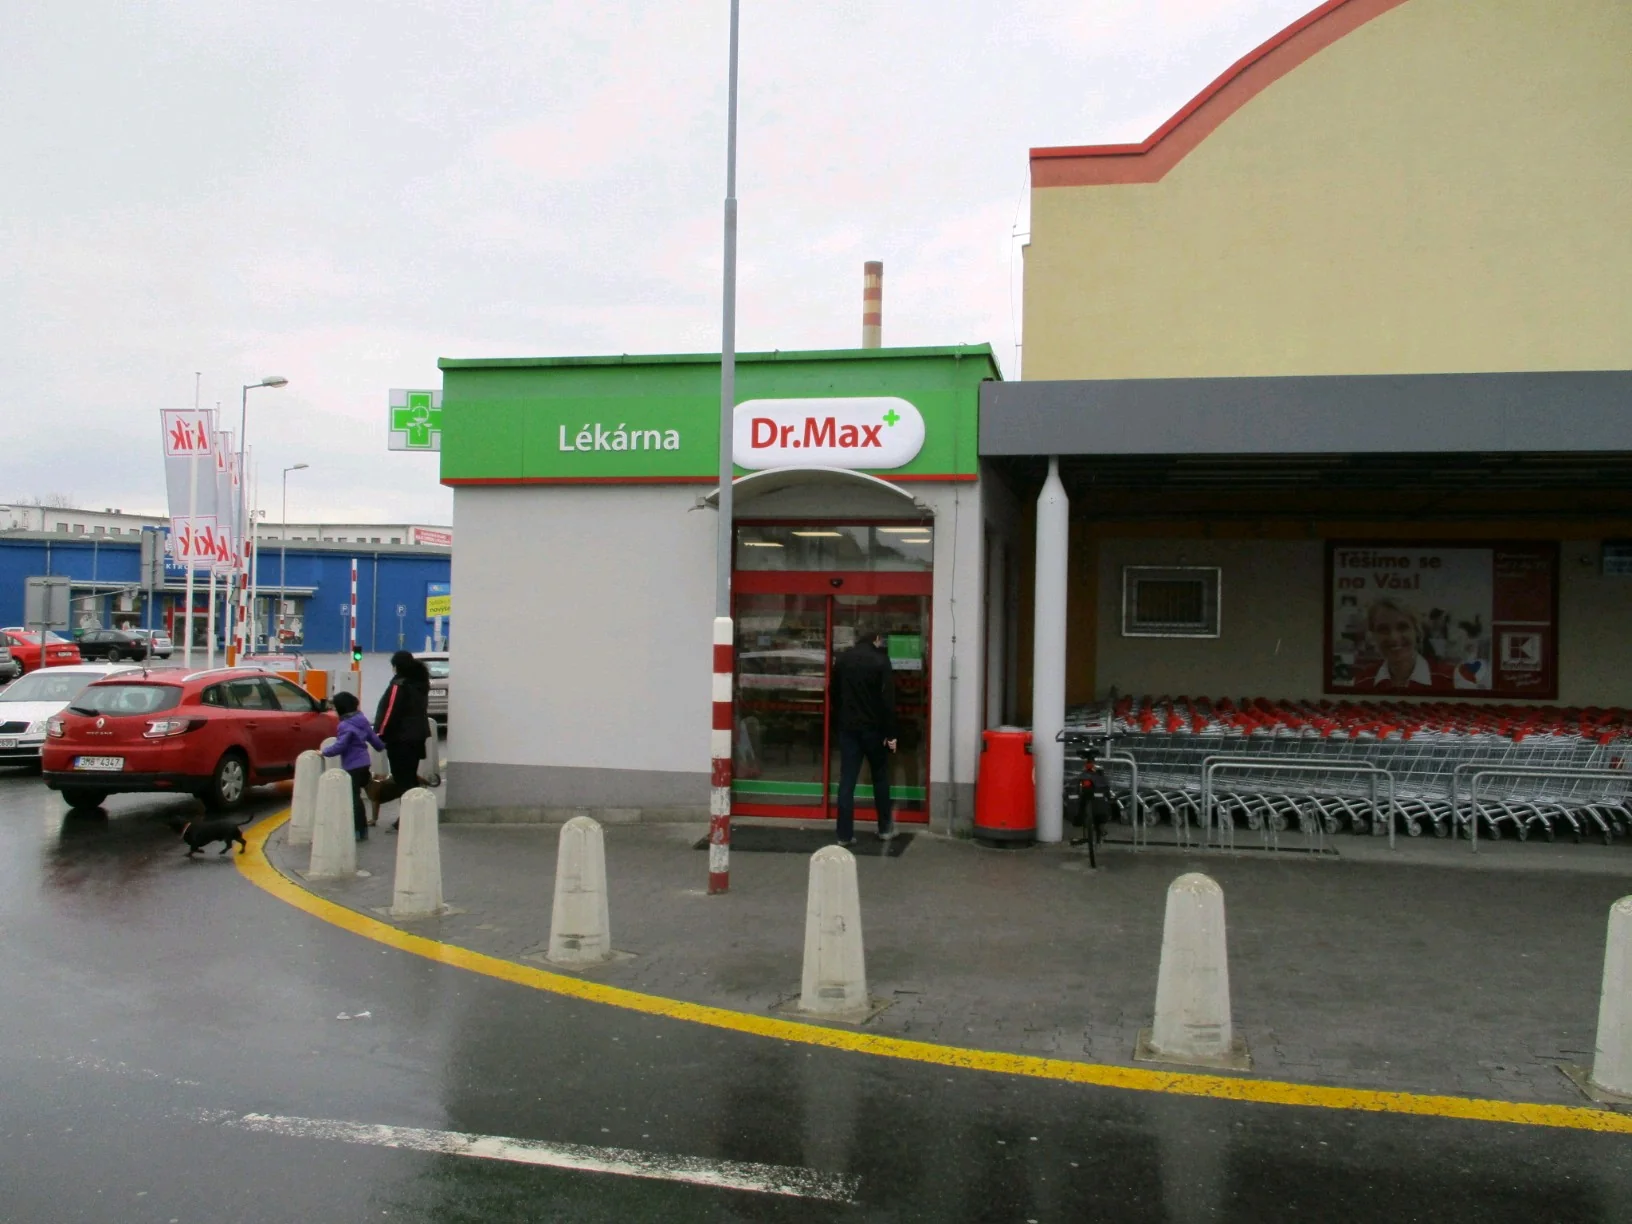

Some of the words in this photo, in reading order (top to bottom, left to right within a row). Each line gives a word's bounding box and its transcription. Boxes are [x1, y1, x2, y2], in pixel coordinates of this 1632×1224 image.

[558, 422, 680, 451] Lékárna
[751, 417, 883, 448] Dr.Max
[1419, 556, 1441, 570] se
[1338, 575, 1365, 590] na
[1374, 573, 1420, 590] Vás!
